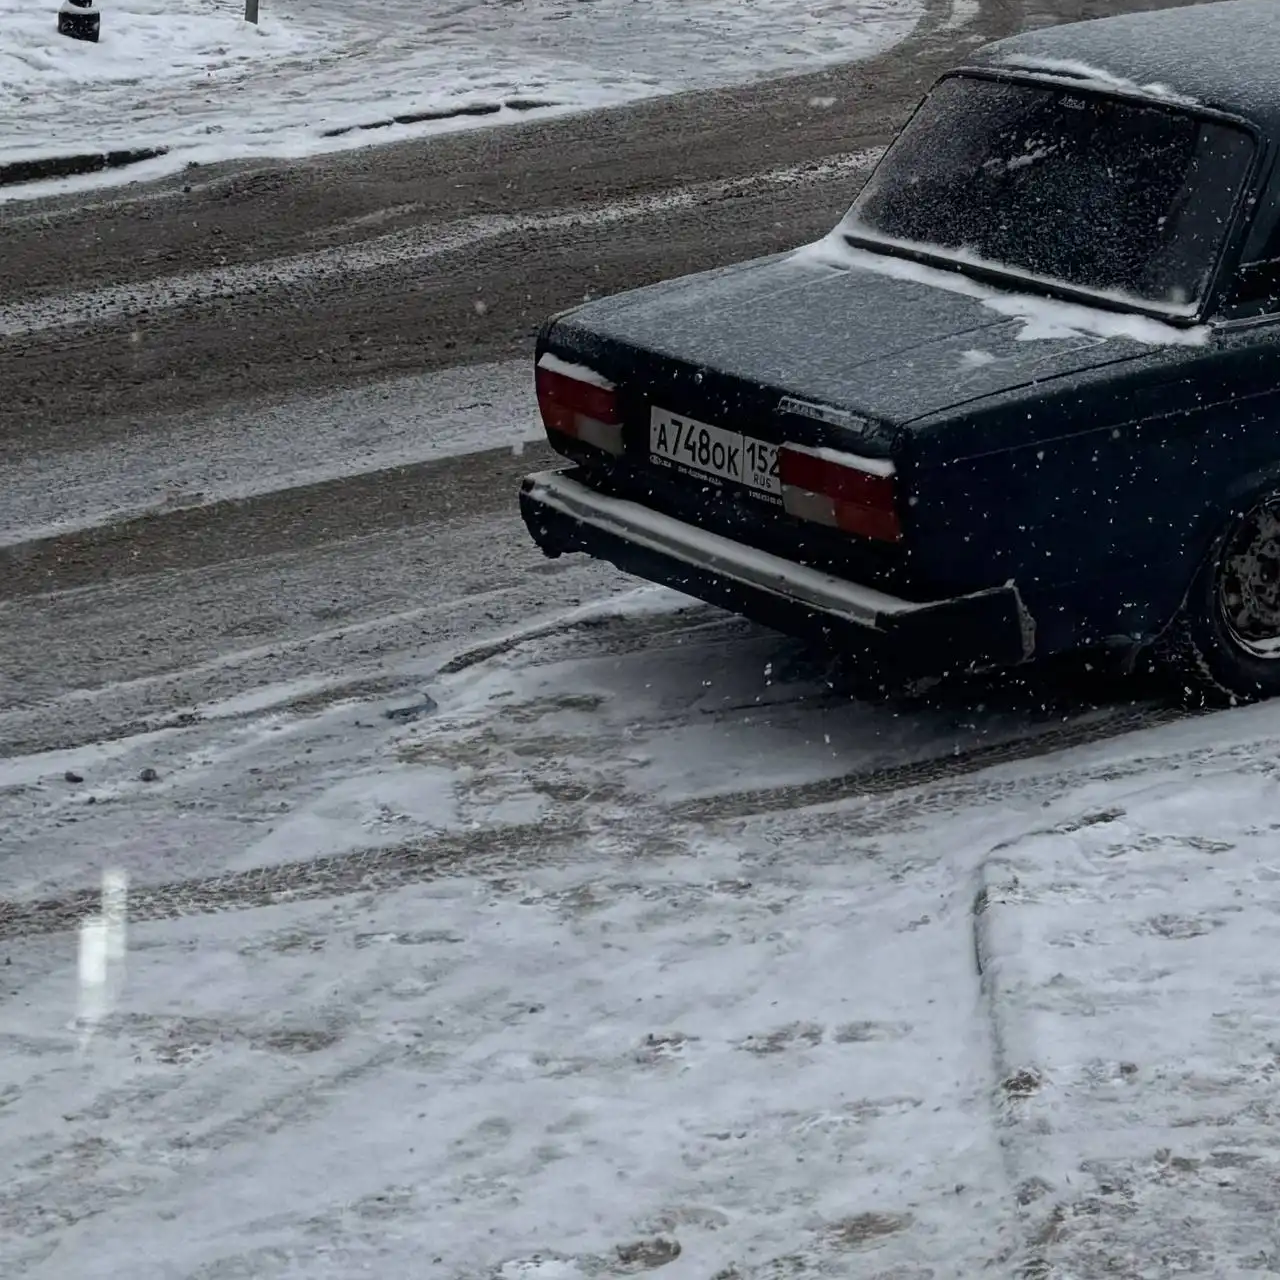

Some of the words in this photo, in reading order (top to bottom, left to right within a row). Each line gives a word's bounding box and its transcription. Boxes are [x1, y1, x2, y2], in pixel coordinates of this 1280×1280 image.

[656, 418, 740, 477] А748ОК
[745, 441, 780, 478] 152
[753, 473, 772, 489] RUS
